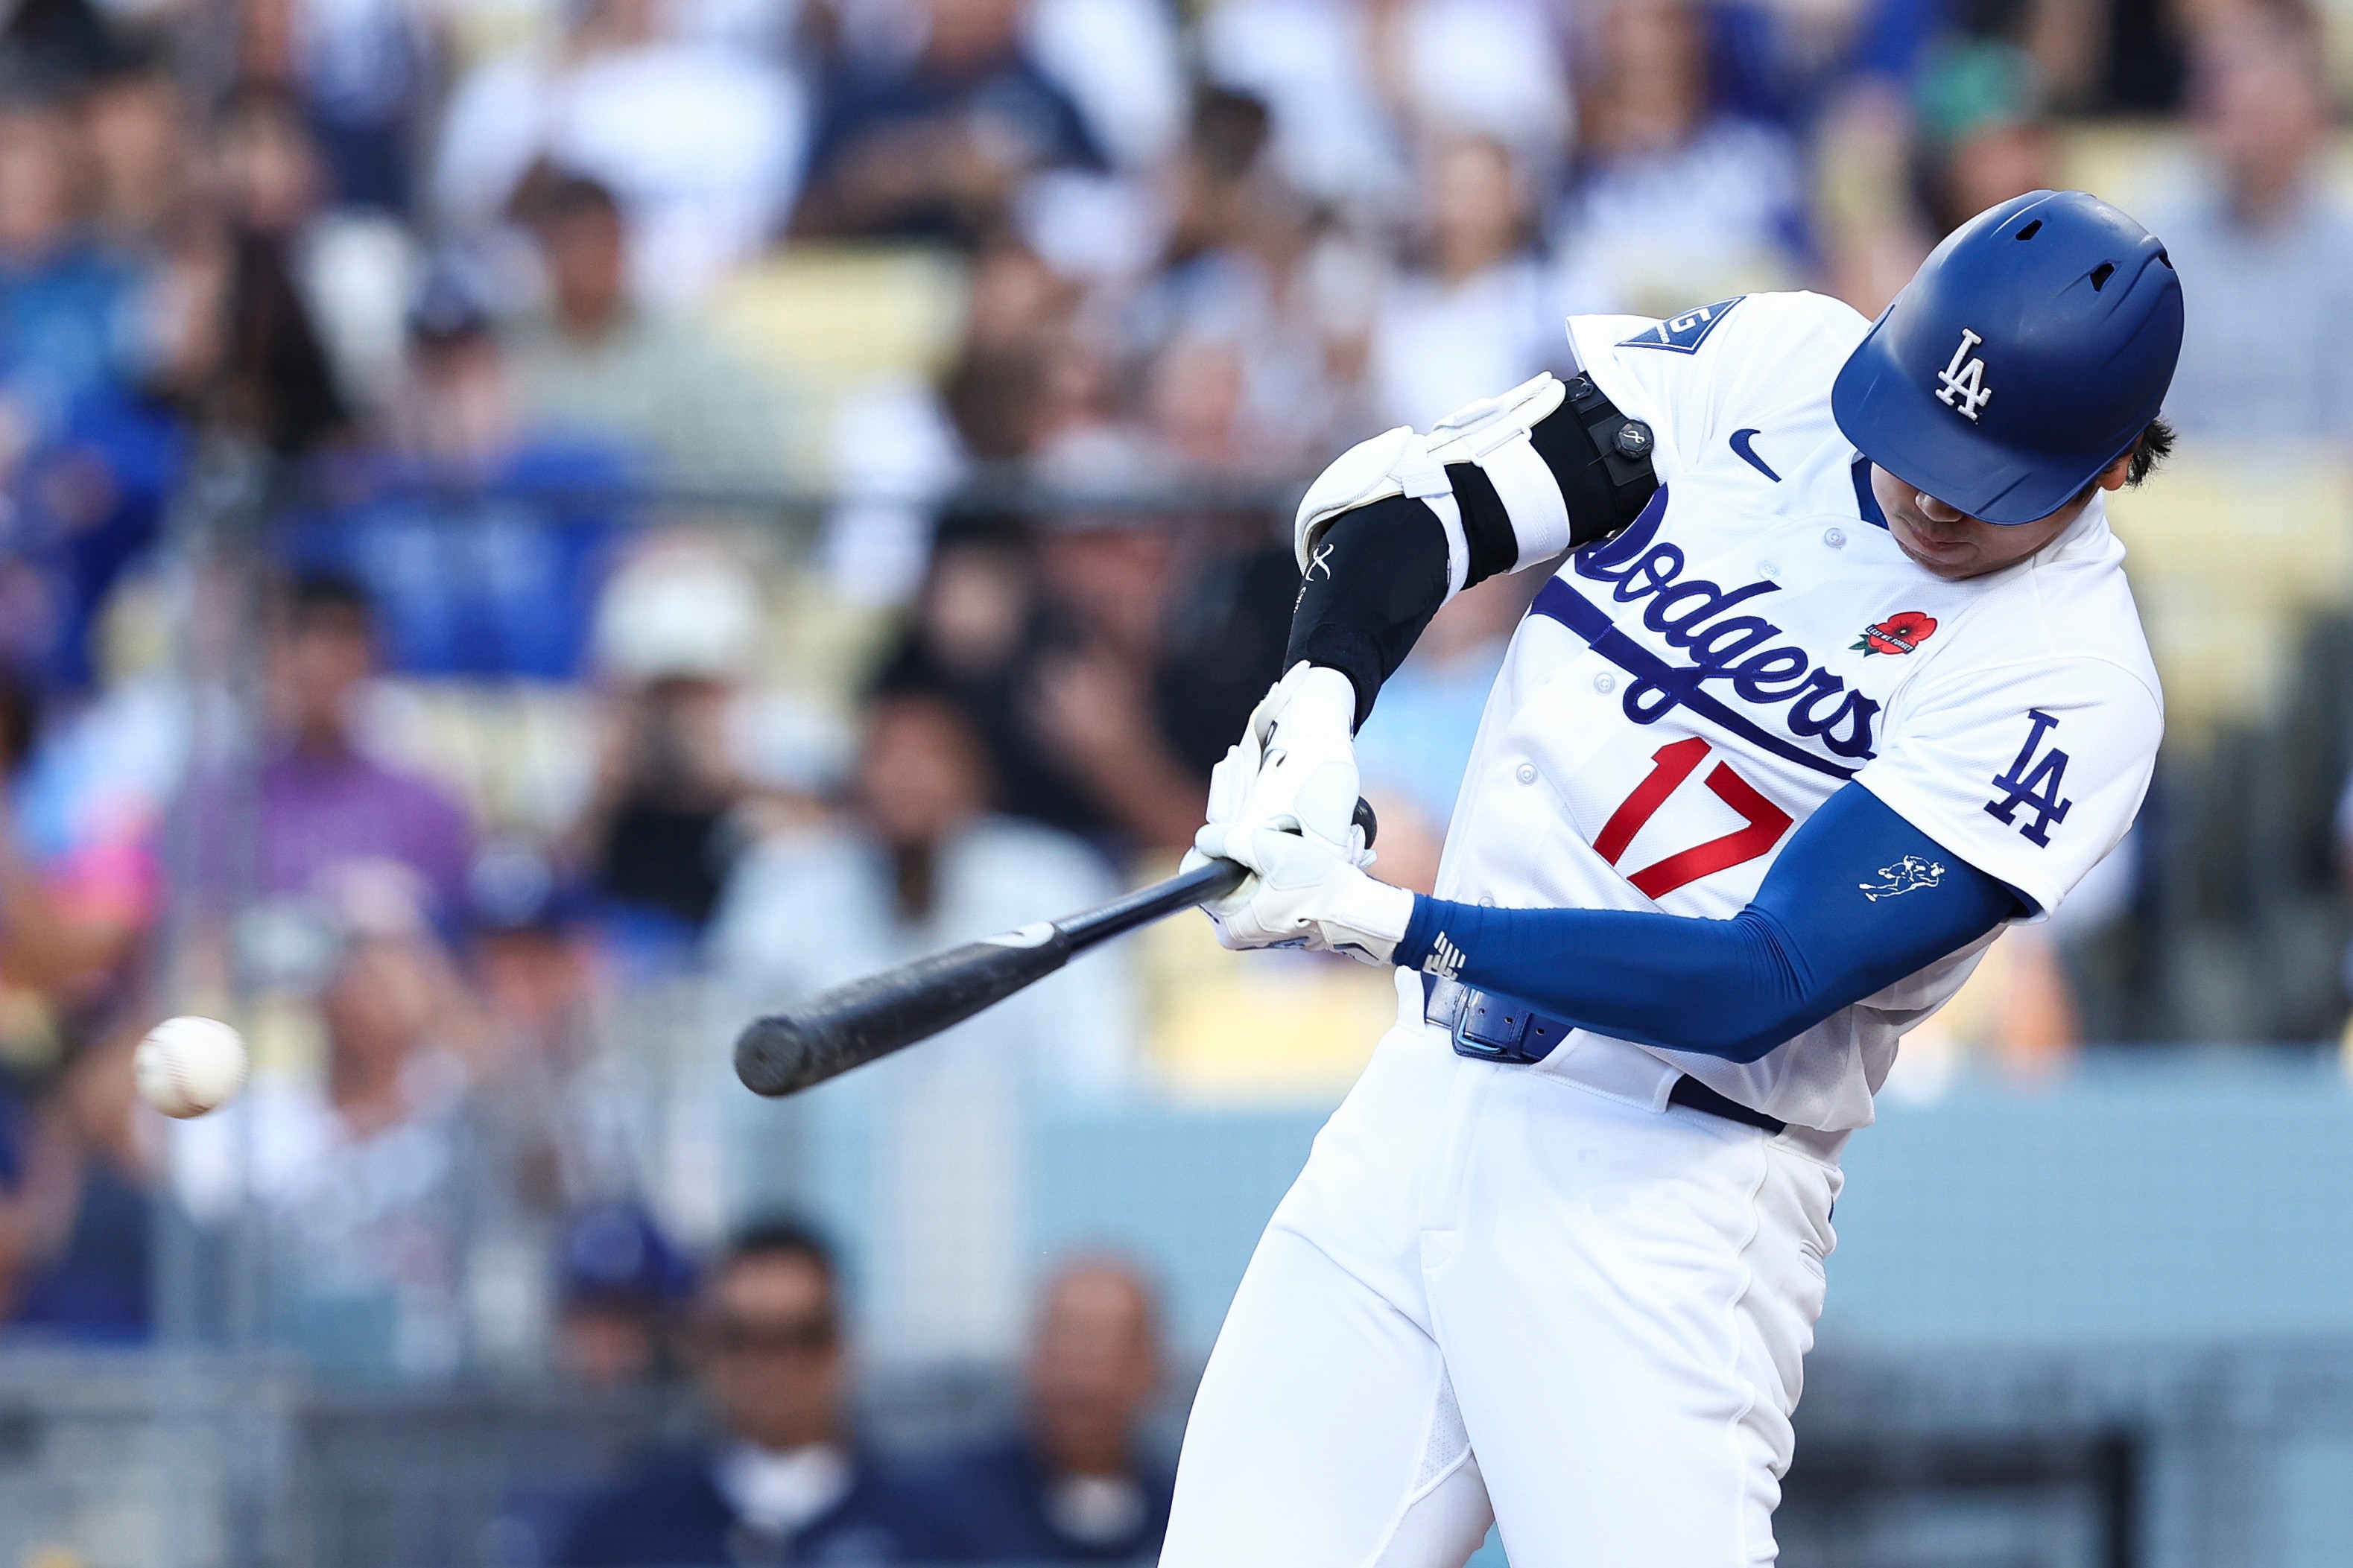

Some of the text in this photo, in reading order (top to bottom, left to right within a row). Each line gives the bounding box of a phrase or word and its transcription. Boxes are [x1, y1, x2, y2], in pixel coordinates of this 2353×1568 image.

[1935, 328, 1992, 421] LA
[1574, 482, 1881, 760] Dodgers
[1866, 626, 1913, 651] LEST WE FORGET
[1592, 736, 1795, 901] 17
[1983, 708, 2073, 849] LA
